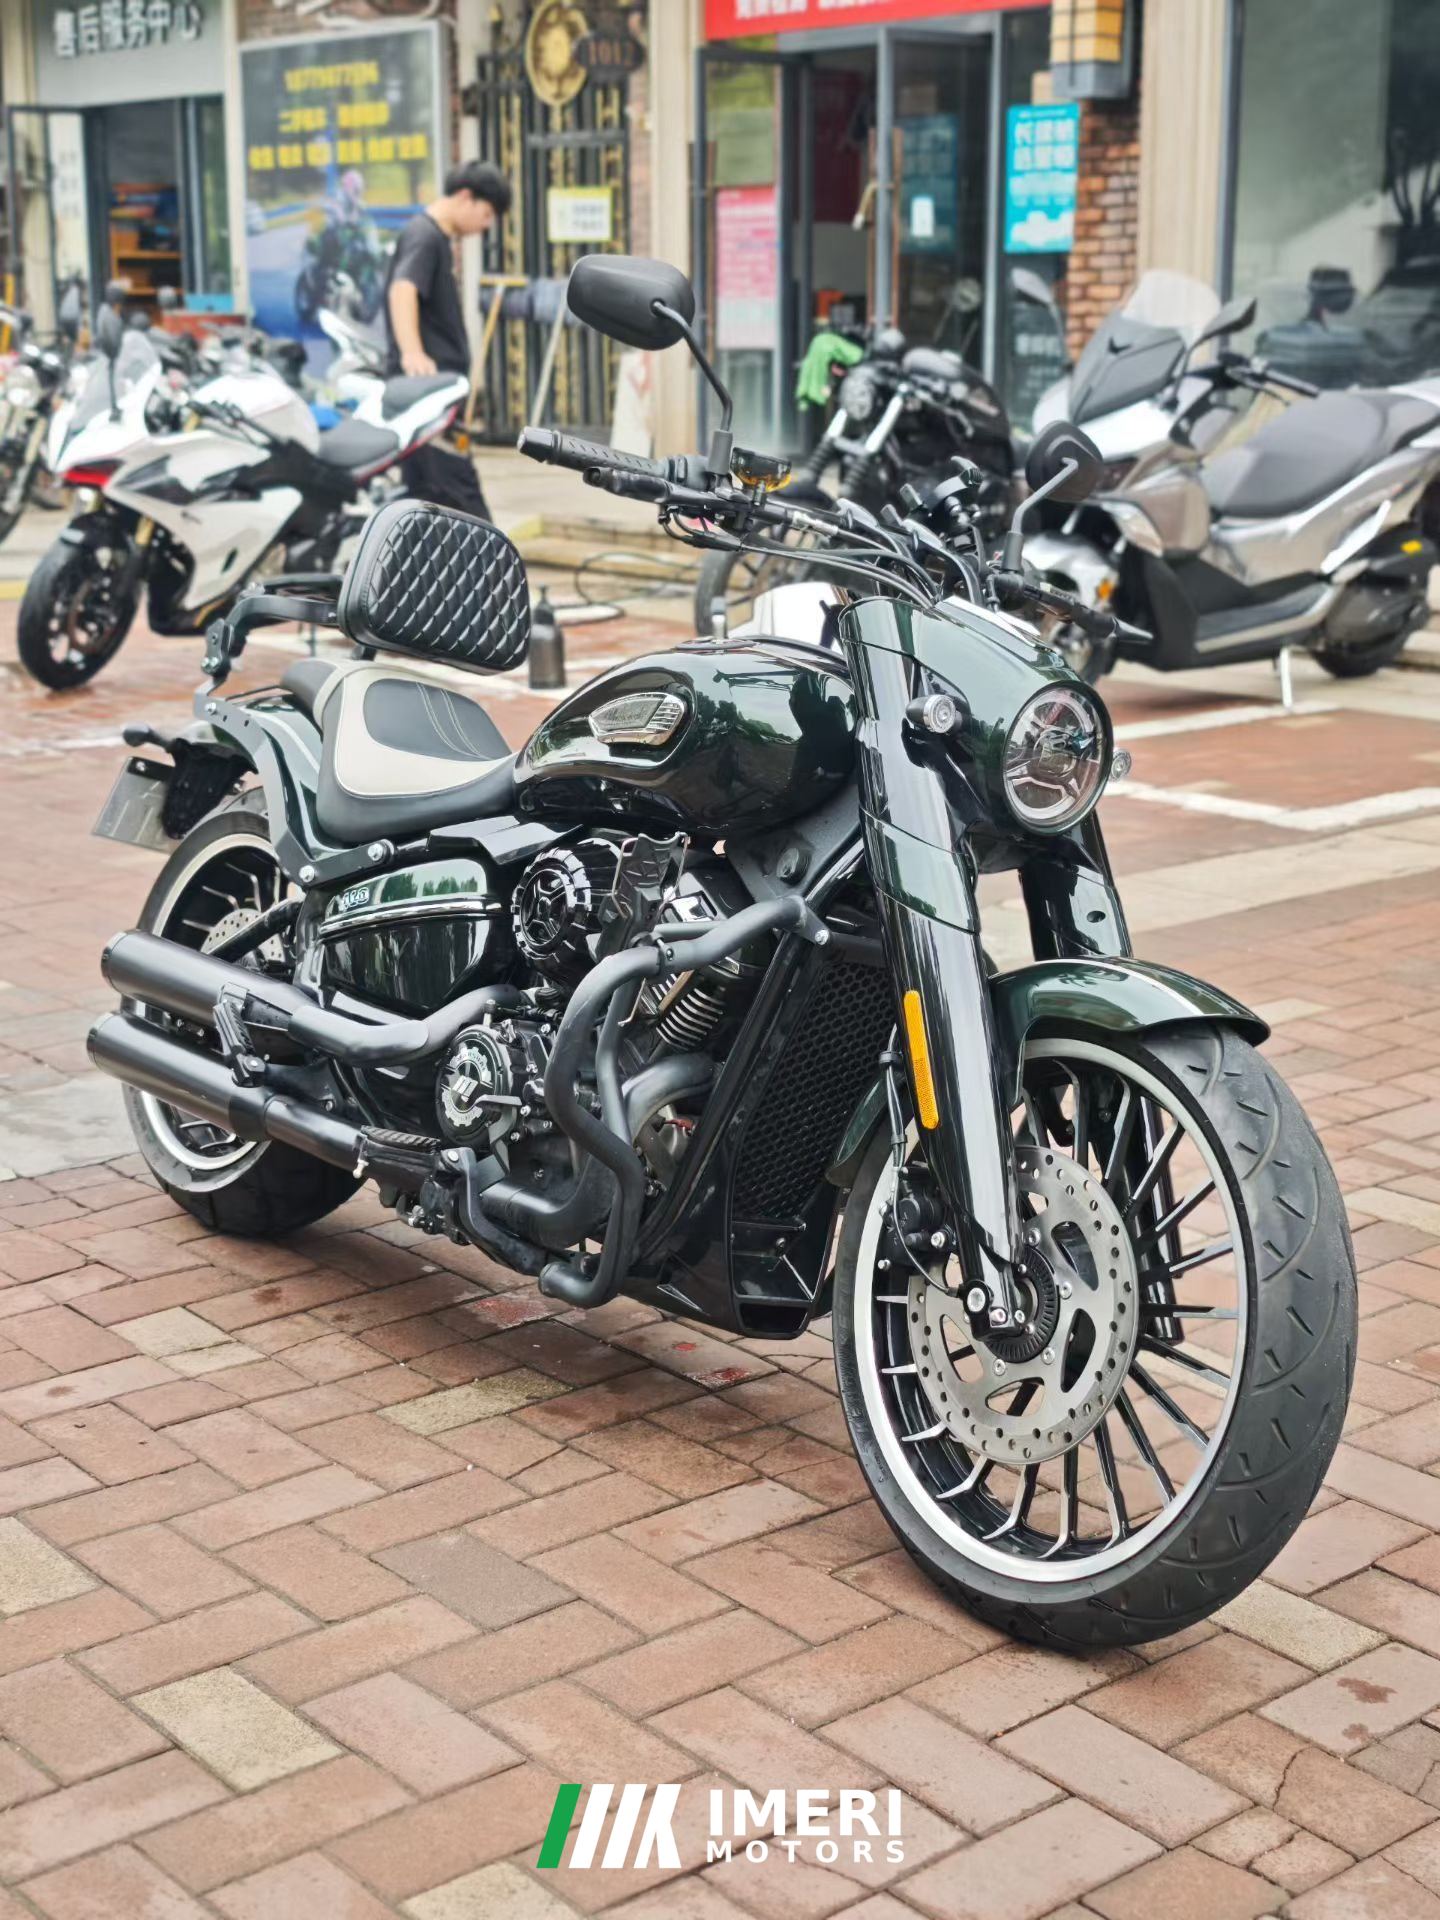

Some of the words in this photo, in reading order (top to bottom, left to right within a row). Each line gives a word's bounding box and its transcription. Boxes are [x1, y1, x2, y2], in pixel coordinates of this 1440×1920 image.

[54, 0, 203, 57] 售后服务中心
